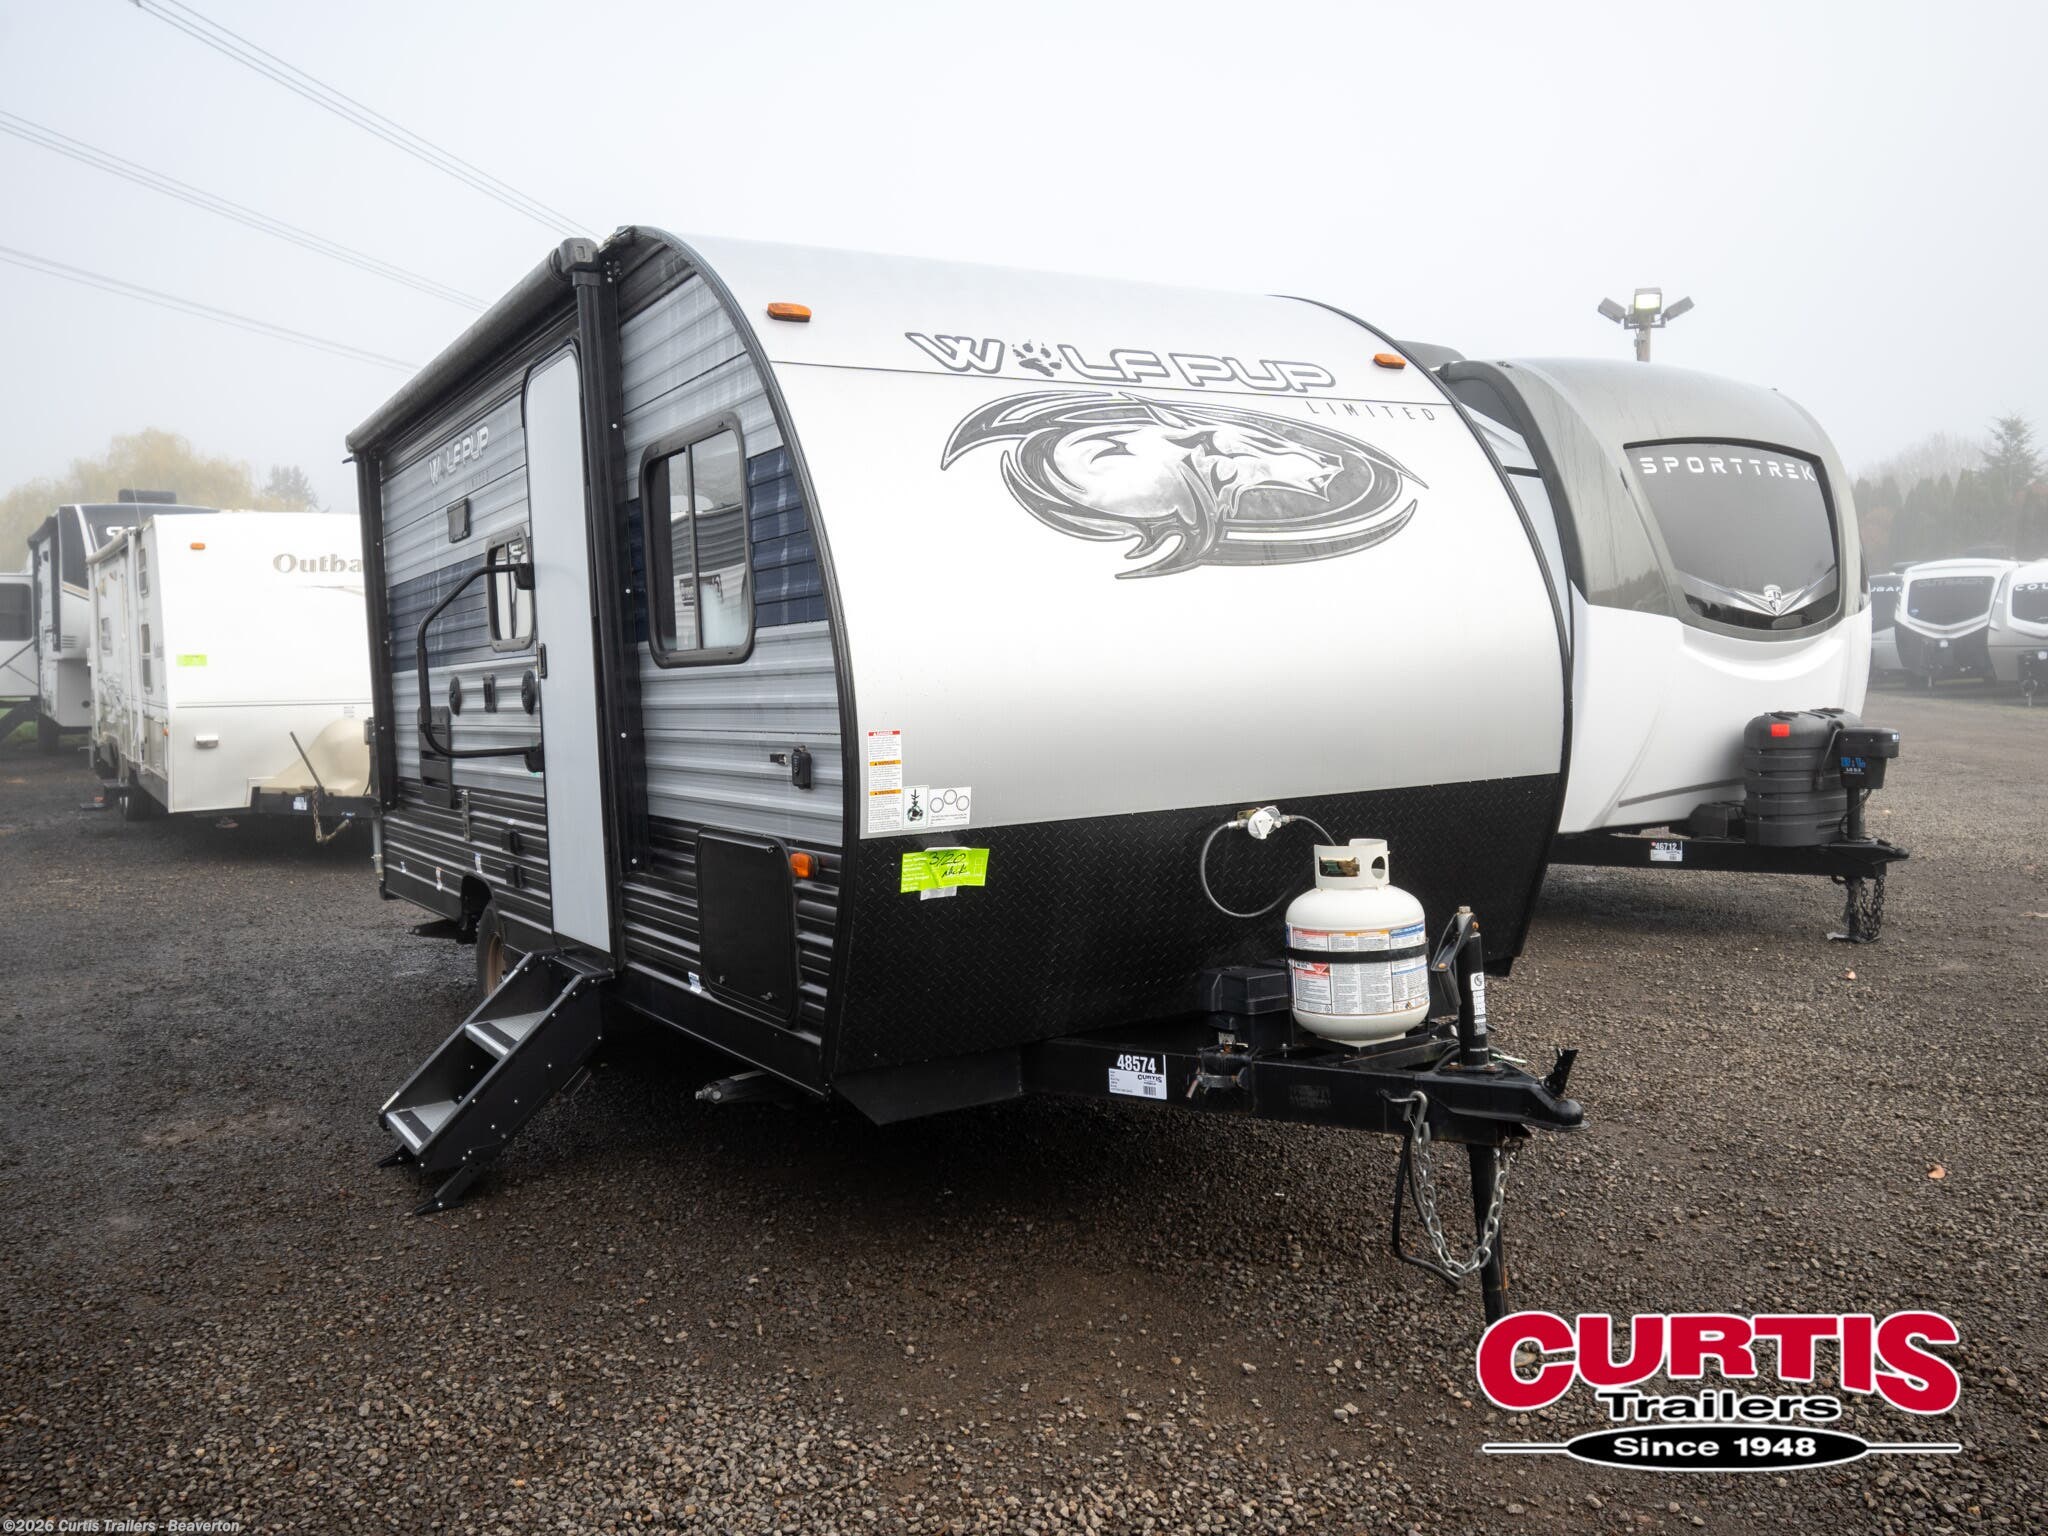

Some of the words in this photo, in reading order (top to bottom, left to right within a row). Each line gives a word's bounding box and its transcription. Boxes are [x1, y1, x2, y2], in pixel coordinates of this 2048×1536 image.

[1305, 401, 1435, 421] LIMITED
[1639, 455, 1815, 482] SPORTTREK
[273, 553, 362, 573] Outba
[1117, 1054, 1156, 1074] 48574
